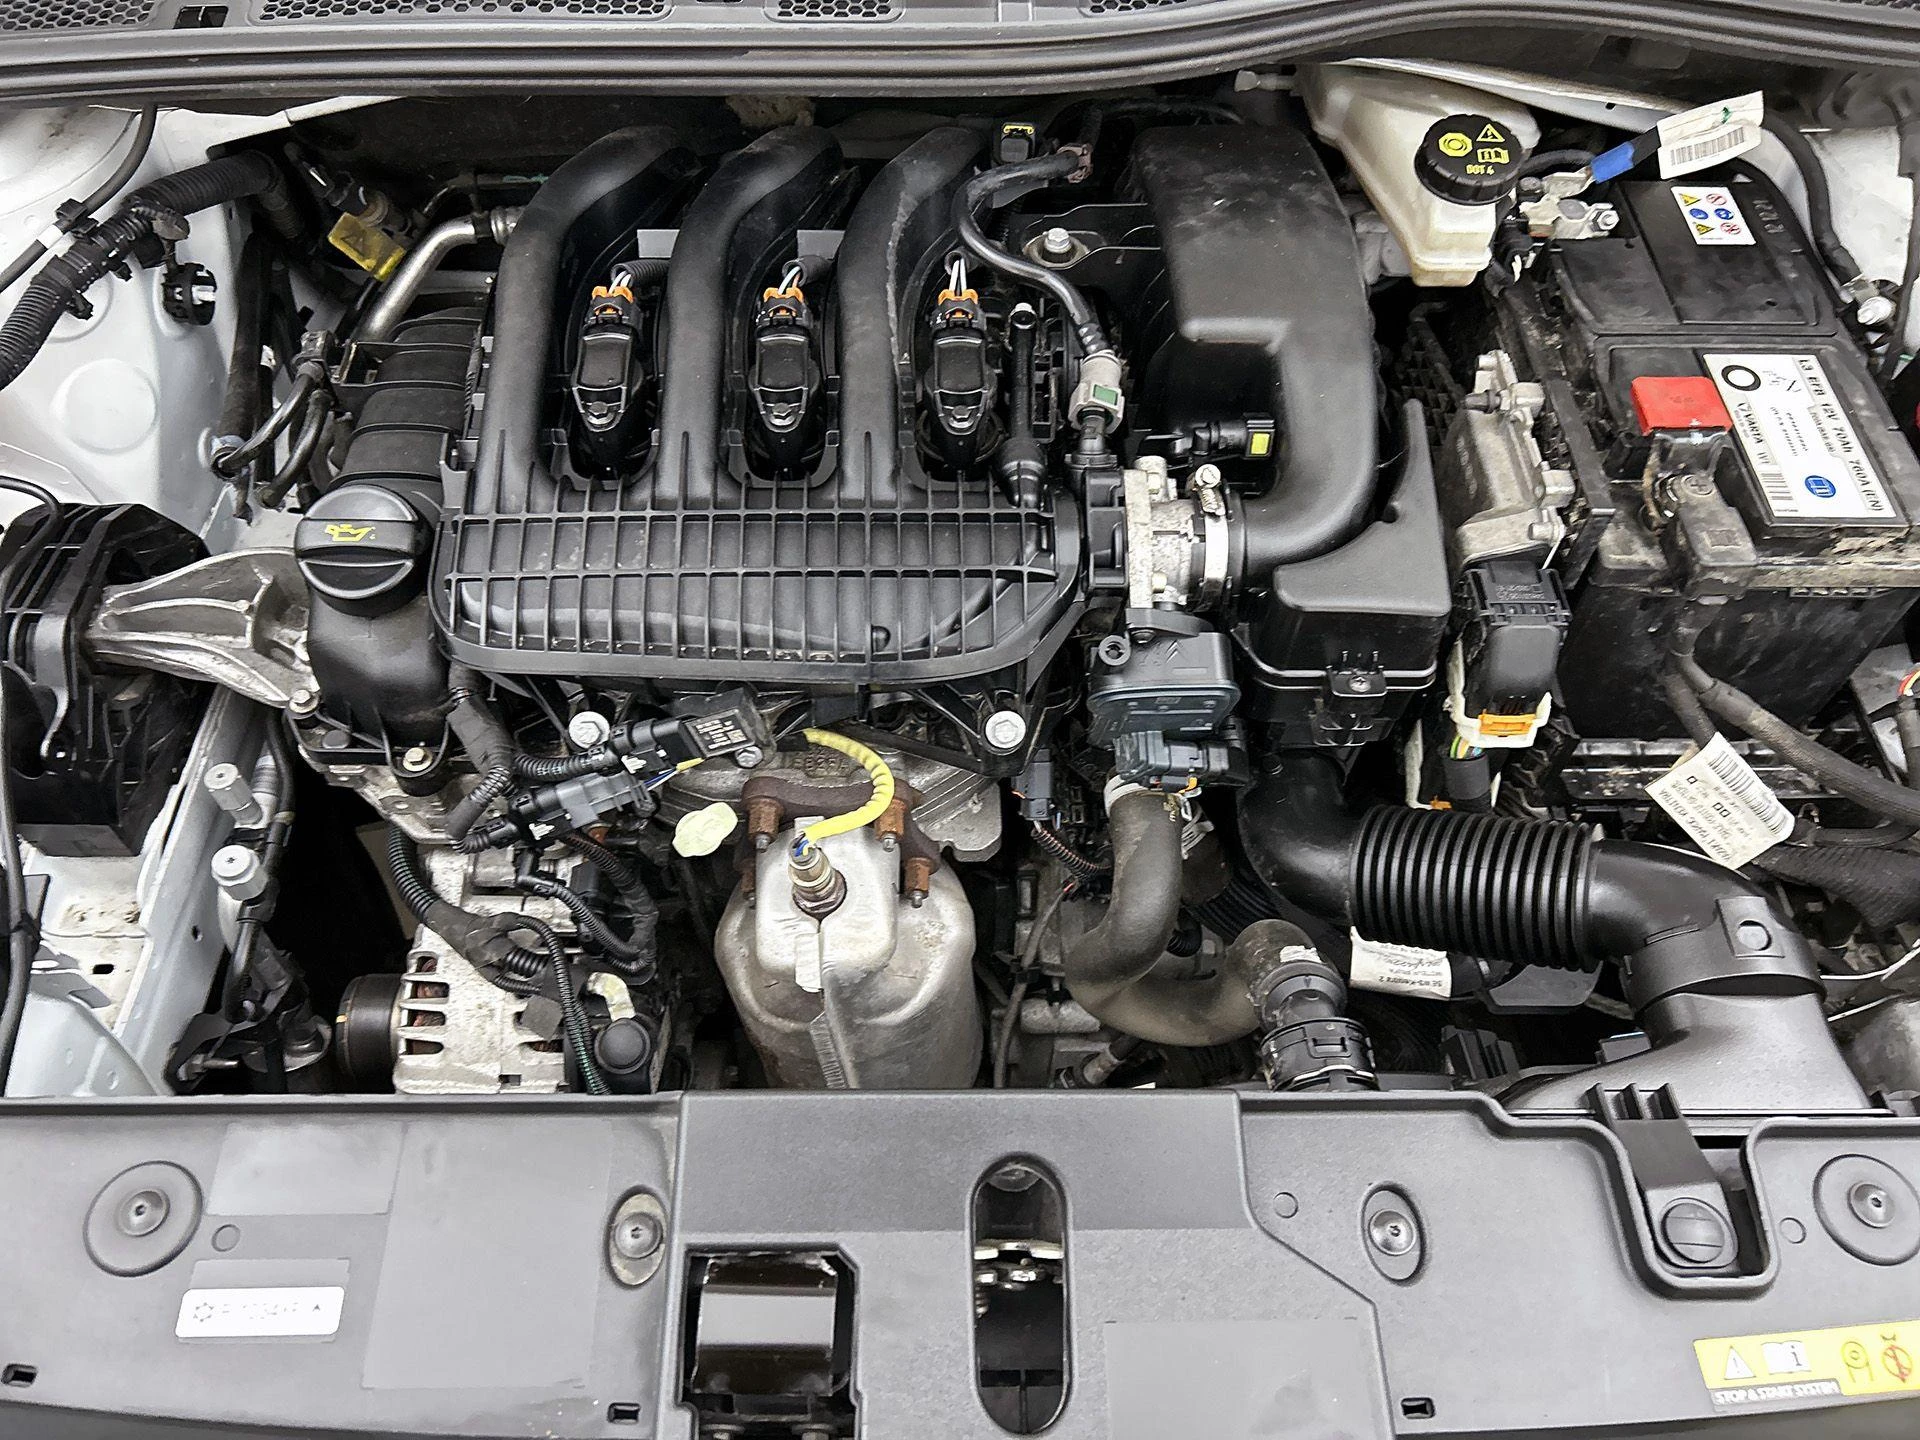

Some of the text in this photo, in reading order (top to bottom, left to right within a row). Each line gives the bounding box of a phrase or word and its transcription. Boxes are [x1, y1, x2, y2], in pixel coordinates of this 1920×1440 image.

[1822, 403, 1840, 421] 12V
[1832, 427, 1852, 454] 70Ah
[1715, 1390, 1747, 1405] STOP
[1758, 1385, 1794, 1400] START
